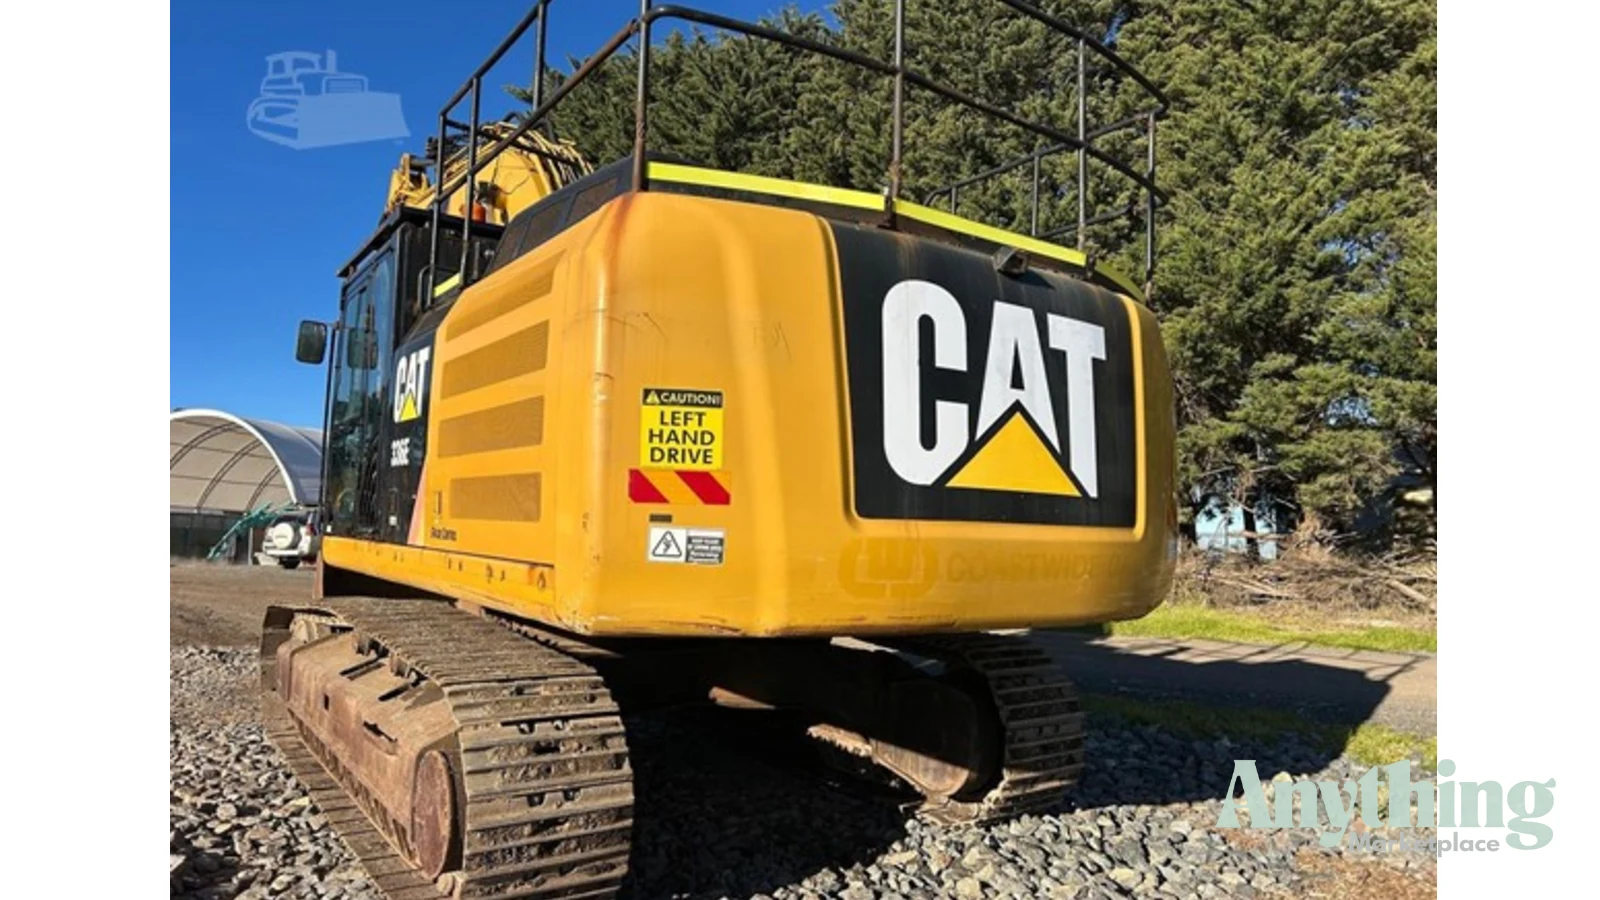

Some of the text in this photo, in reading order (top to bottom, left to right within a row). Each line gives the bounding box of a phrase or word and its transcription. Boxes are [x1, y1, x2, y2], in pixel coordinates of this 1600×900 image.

[393, 346, 430, 424] CAT
[881, 279, 1107, 499] CAT
[660, 391, 721, 405] CAUTION!
[660, 410, 706, 427] LEFT
[648, 428, 715, 446] HAND
[650, 446, 713, 465] DRIVE
[947, 551, 1101, 582] COSTWIDE
